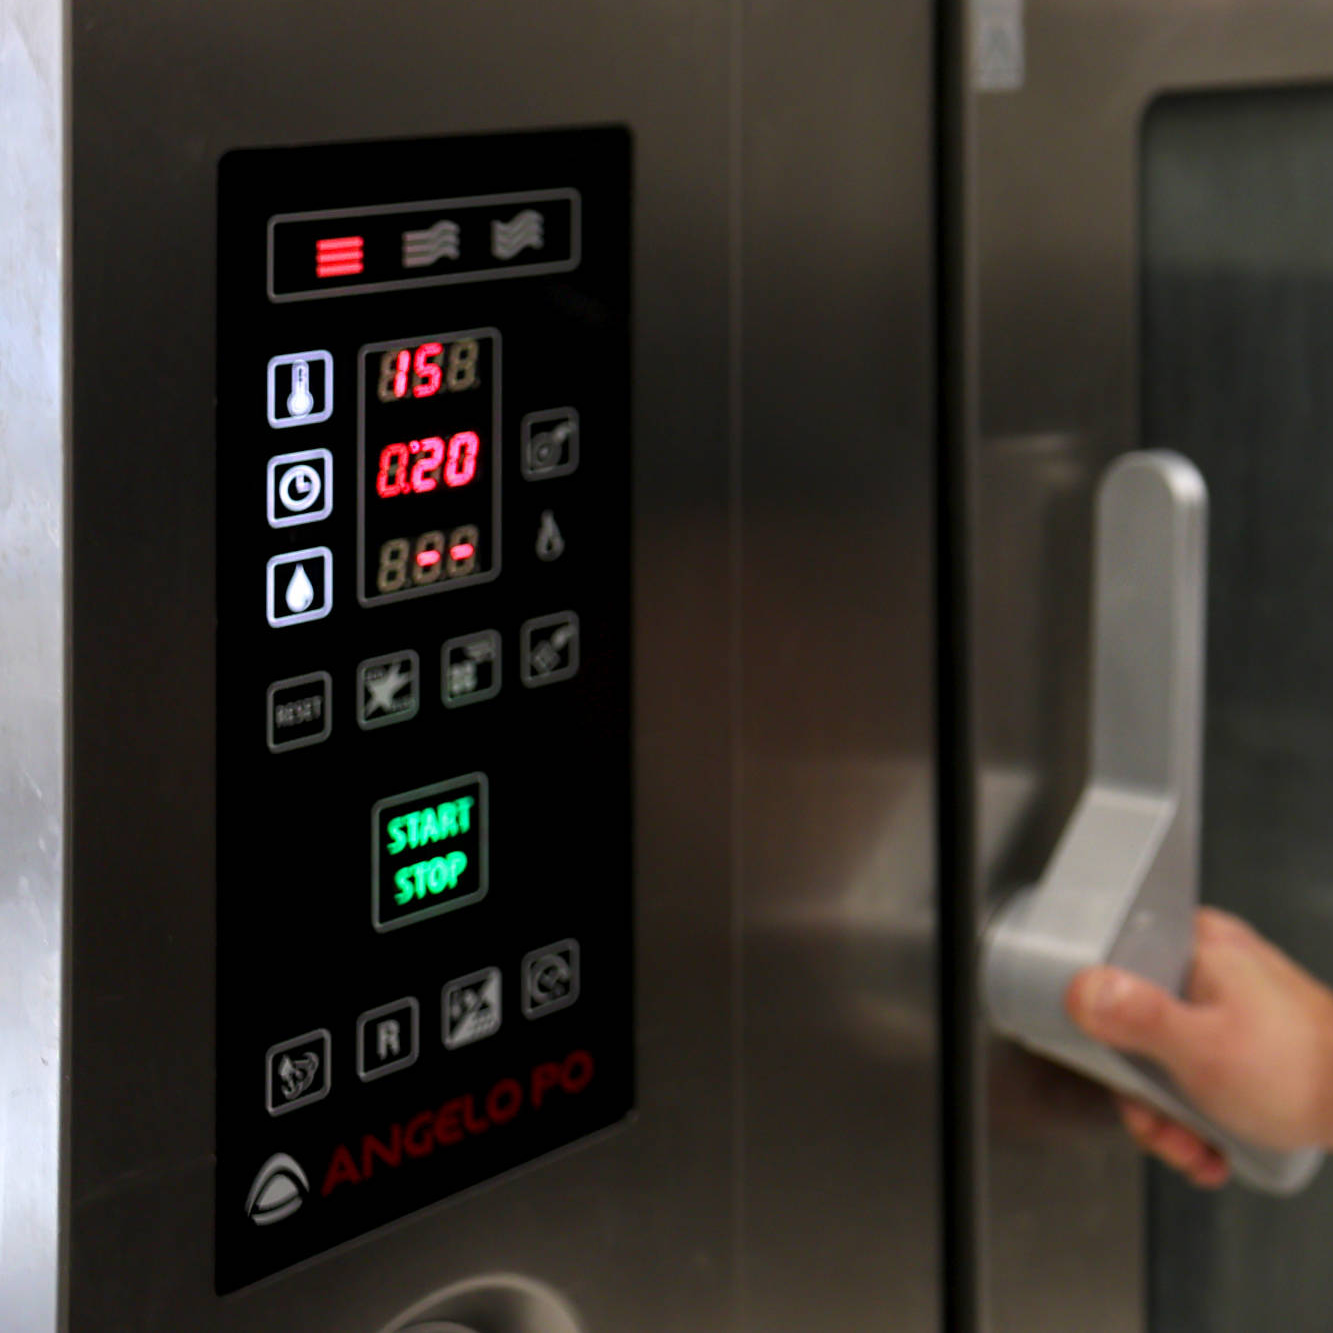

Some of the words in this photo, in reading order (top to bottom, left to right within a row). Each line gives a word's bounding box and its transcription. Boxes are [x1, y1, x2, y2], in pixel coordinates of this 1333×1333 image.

[276, 696, 321, 728] RESET
[387, 797, 473, 853] START
[395, 852, 467, 904] STOP
[376, 1018, 401, 1061] R
[323, 1078, 522, 1195] ANGELO
[531, 1050, 593, 1107] PO
